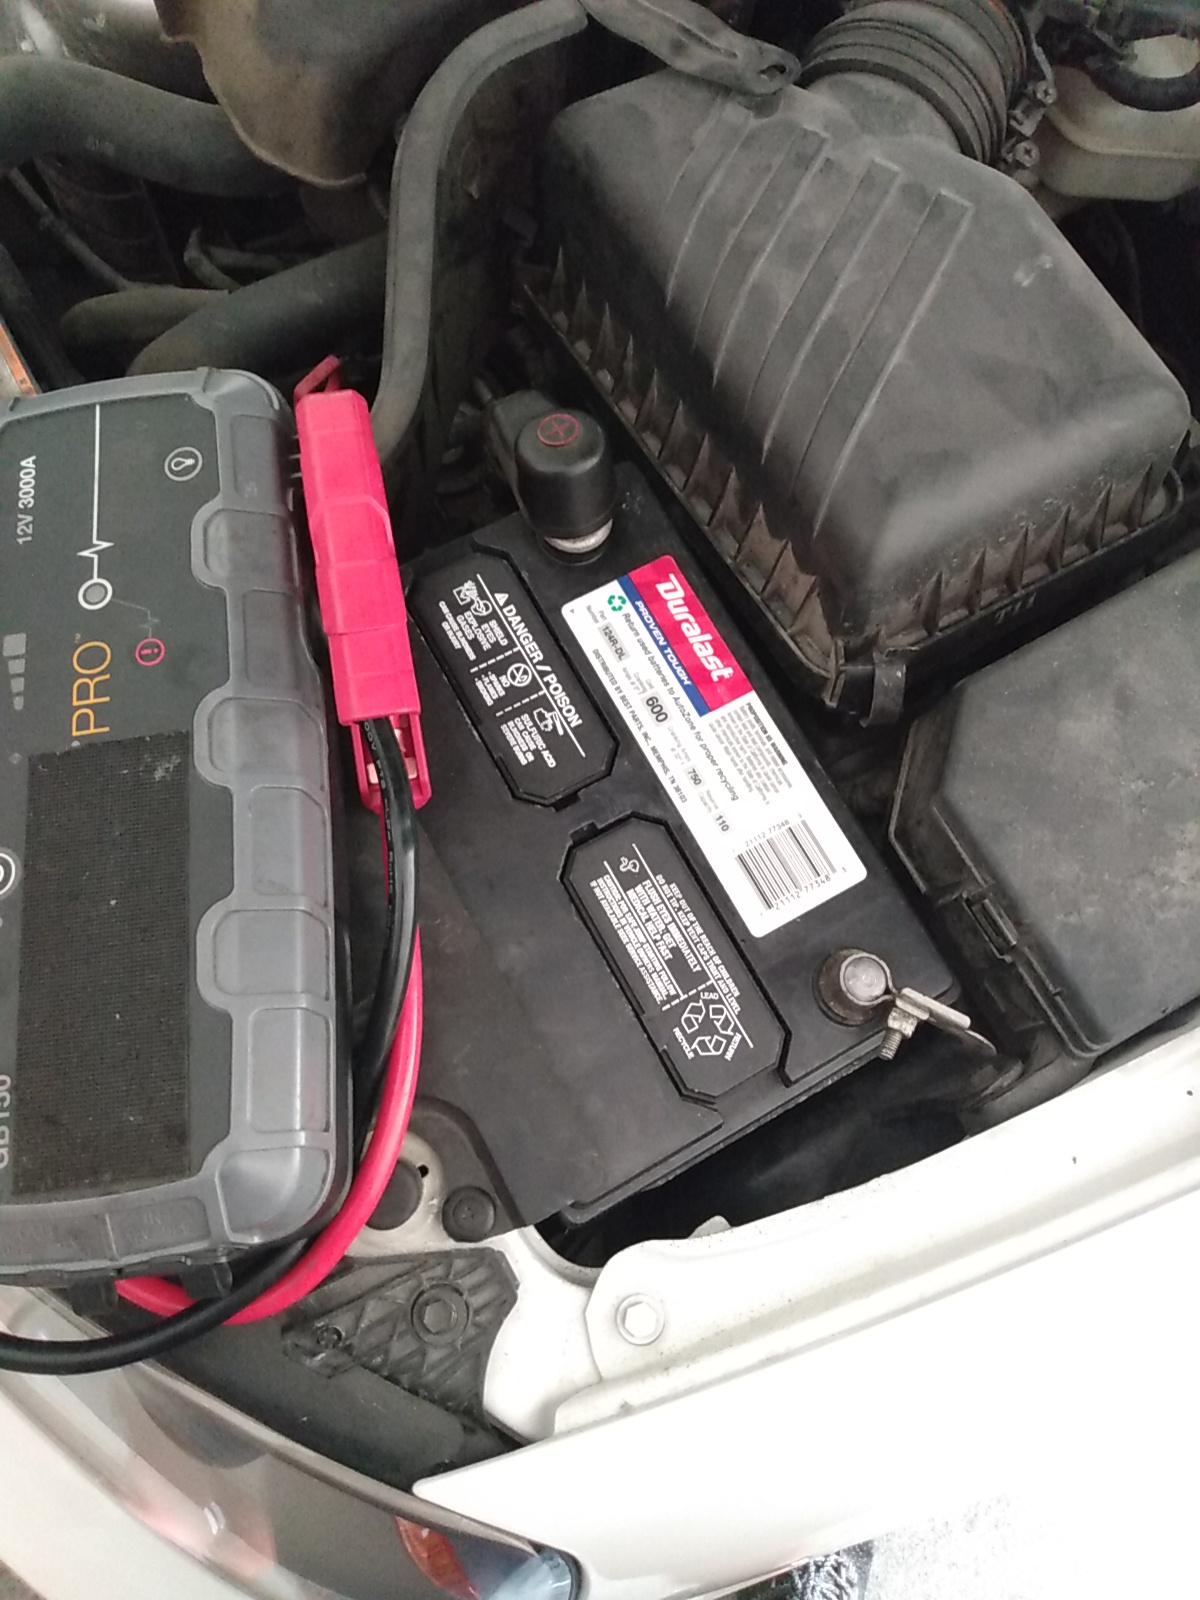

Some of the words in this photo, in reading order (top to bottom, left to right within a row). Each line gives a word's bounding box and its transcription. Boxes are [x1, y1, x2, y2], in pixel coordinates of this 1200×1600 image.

[18, 454, 36, 509] 3000A
[16, 513, 33, 545] 12V
[456, 614, 476, 641] GASES
[462, 610, 492, 652] EXPLOSIVE
[480, 622, 497, 644] EYES
[488, 619, 509, 647] SHIELD
[621, 612, 641, 638] Return
[655, 572, 735, 683] Duralast
[600, 624, 628, 662] 124R-DL
[634, 600, 668, 647] PROVEN
[663, 646, 692, 686] TOUGH
[636, 637, 653, 656] used
[498, 674, 511, 688] NO
[502, 603, 544, 664] DANGER
[542, 672, 583, 729] POISON
[647, 654, 671, 688] batteries
[71, 640, 112, 736] PRO
[666, 686, 676, 696] to
[643, 693, 671, 726] 600
[671, 696, 697, 731] AutoZone
[520, 713, 547, 751] SULFURIC
[540, 749, 557, 768] ACID
[592, 648, 618, 686] DISTRIBUTED
[613, 685, 624, 695] BY
[619, 694, 633, 710] BEST
[628, 709, 645, 733] PARTS,
[667, 774, 677, 786] TN
[672, 784, 688, 804] 38103
[693, 730, 704, 743] for
[698, 742, 719, 767] proper
[686, 767, 704, 788] 750
[715, 767, 740, 802] recycling
[714, 813, 732, 834] 110
[744, 831, 767, 848] 21112
[668, 882, 683, 900] KEEP
[678, 898, 692, 913] OUT
[773, 890, 802, 911] 21112
[803, 872, 832, 894] 77348
[625, 888, 652, 924] MEDICAL
[644, 920, 662, 941] HELP
[655, 939, 674, 961] FAST
[634, 883, 652, 906] WITH
[662, 932, 677, 949] GET
[641, 879, 663, 906] FLUSH
[655, 903, 673, 924] EYES
[664, 921, 703, 973] IMMEDIATELY
[686, 911, 697, 922] OF
[691, 920, 704, 936] THE
[655, 873, 666, 886] DO
[696, 942, 711, 962] CAPS
[716, 979, 730, 995] AND
[725, 992, 741, 1016] LEVEL
[699, 933, 717, 957] REACH
[711, 954, 723, 965] OF
[700, 991, 719, 1000] LEAD
[715, 964, 741, 998] CHILDREN
[672, 1026, 695, 1060] RECYCLE
[724, 1032, 742, 1062] RETURN
